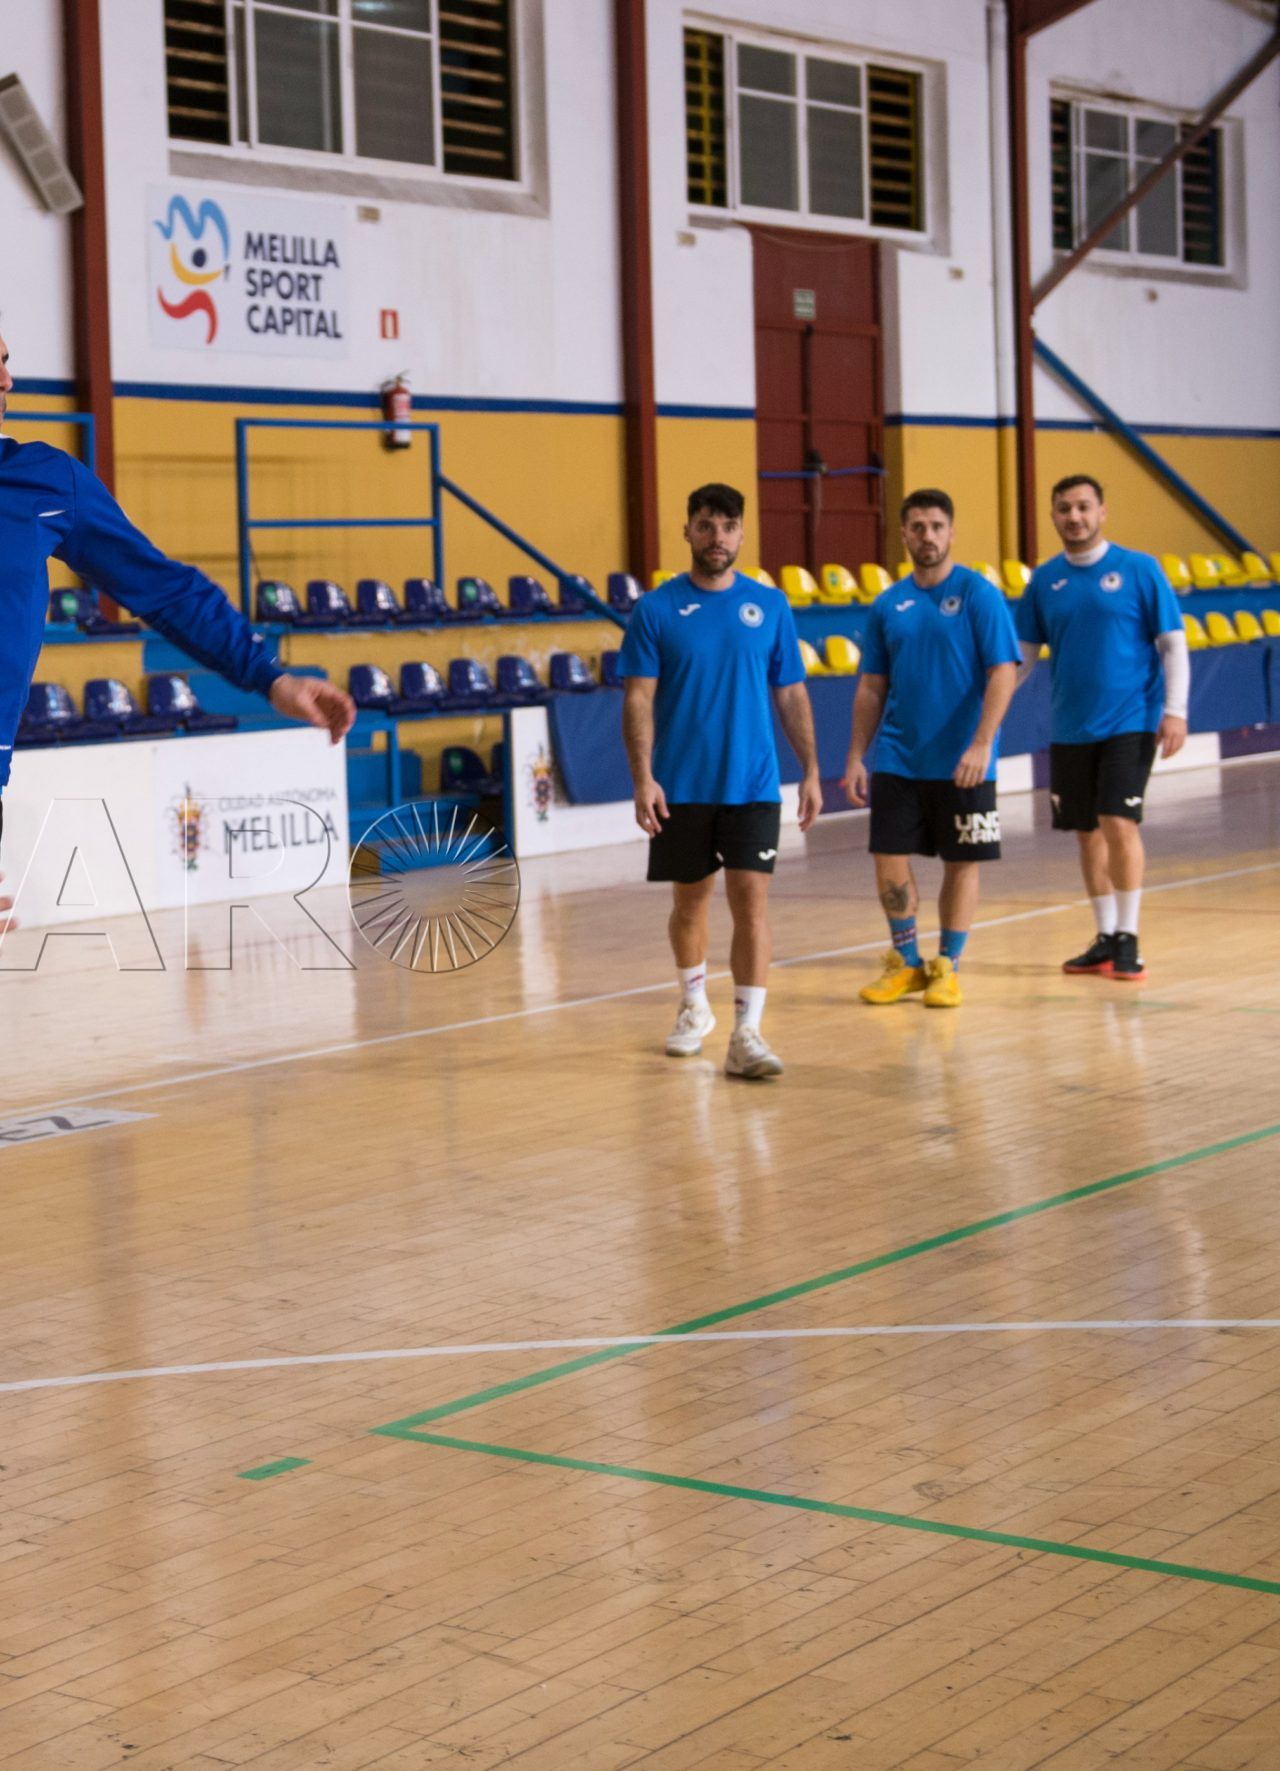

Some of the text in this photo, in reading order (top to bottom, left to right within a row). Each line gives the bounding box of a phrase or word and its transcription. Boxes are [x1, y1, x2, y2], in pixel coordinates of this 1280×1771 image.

[243, 231, 341, 269] MELILLA
[246, 267, 323, 301] SPORT
[246, 304, 343, 338] CAPITAL
[222, 810, 340, 855] MELILLA
